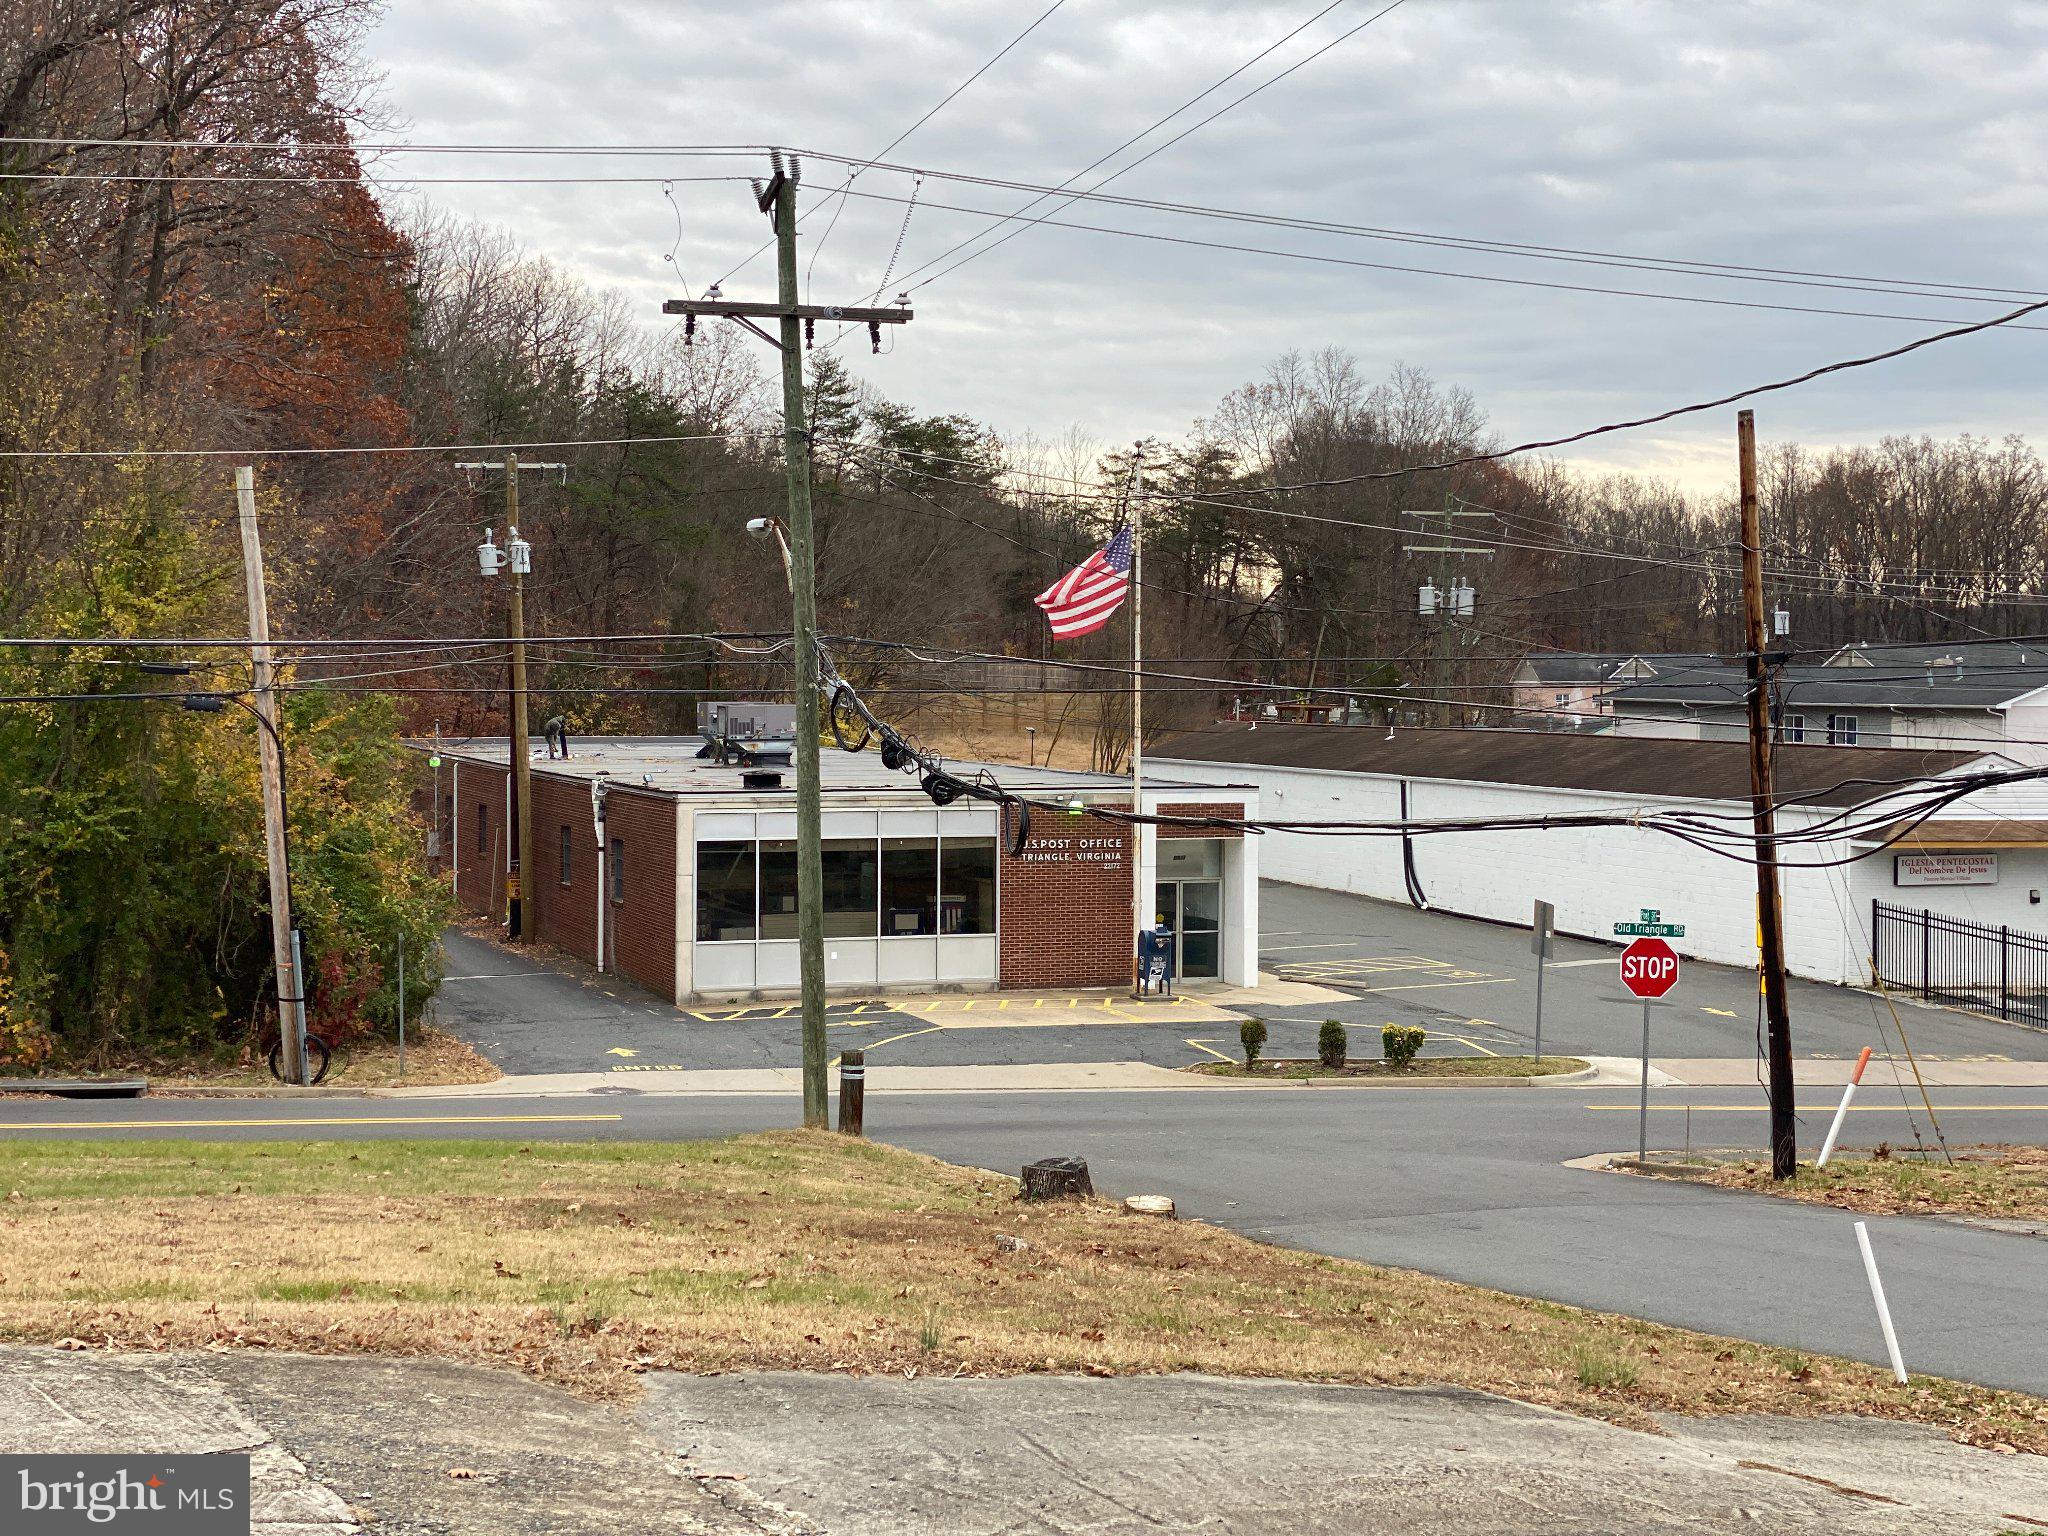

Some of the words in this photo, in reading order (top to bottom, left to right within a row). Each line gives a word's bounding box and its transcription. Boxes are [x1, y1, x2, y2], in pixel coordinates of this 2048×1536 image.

[1079, 838, 1122, 848] OFFICE
[1076, 852, 1121, 860] VIRGINIA
[1901, 858, 1934, 867] IGLESIA
[1936, 857, 1994, 866] PENTECOSTAL
[1909, 866, 1922, 875] Del
[1924, 866, 1954, 875] Nombre
[1956, 866, 1966, 874] De
[1968, 865, 1988, 874] Jesus
[1617, 923, 1631, 932] Old
[1634, 924, 1668, 936] Triangle
[1673, 925, 1684, 933] RD
[1624, 955, 1675, 979] STOP
